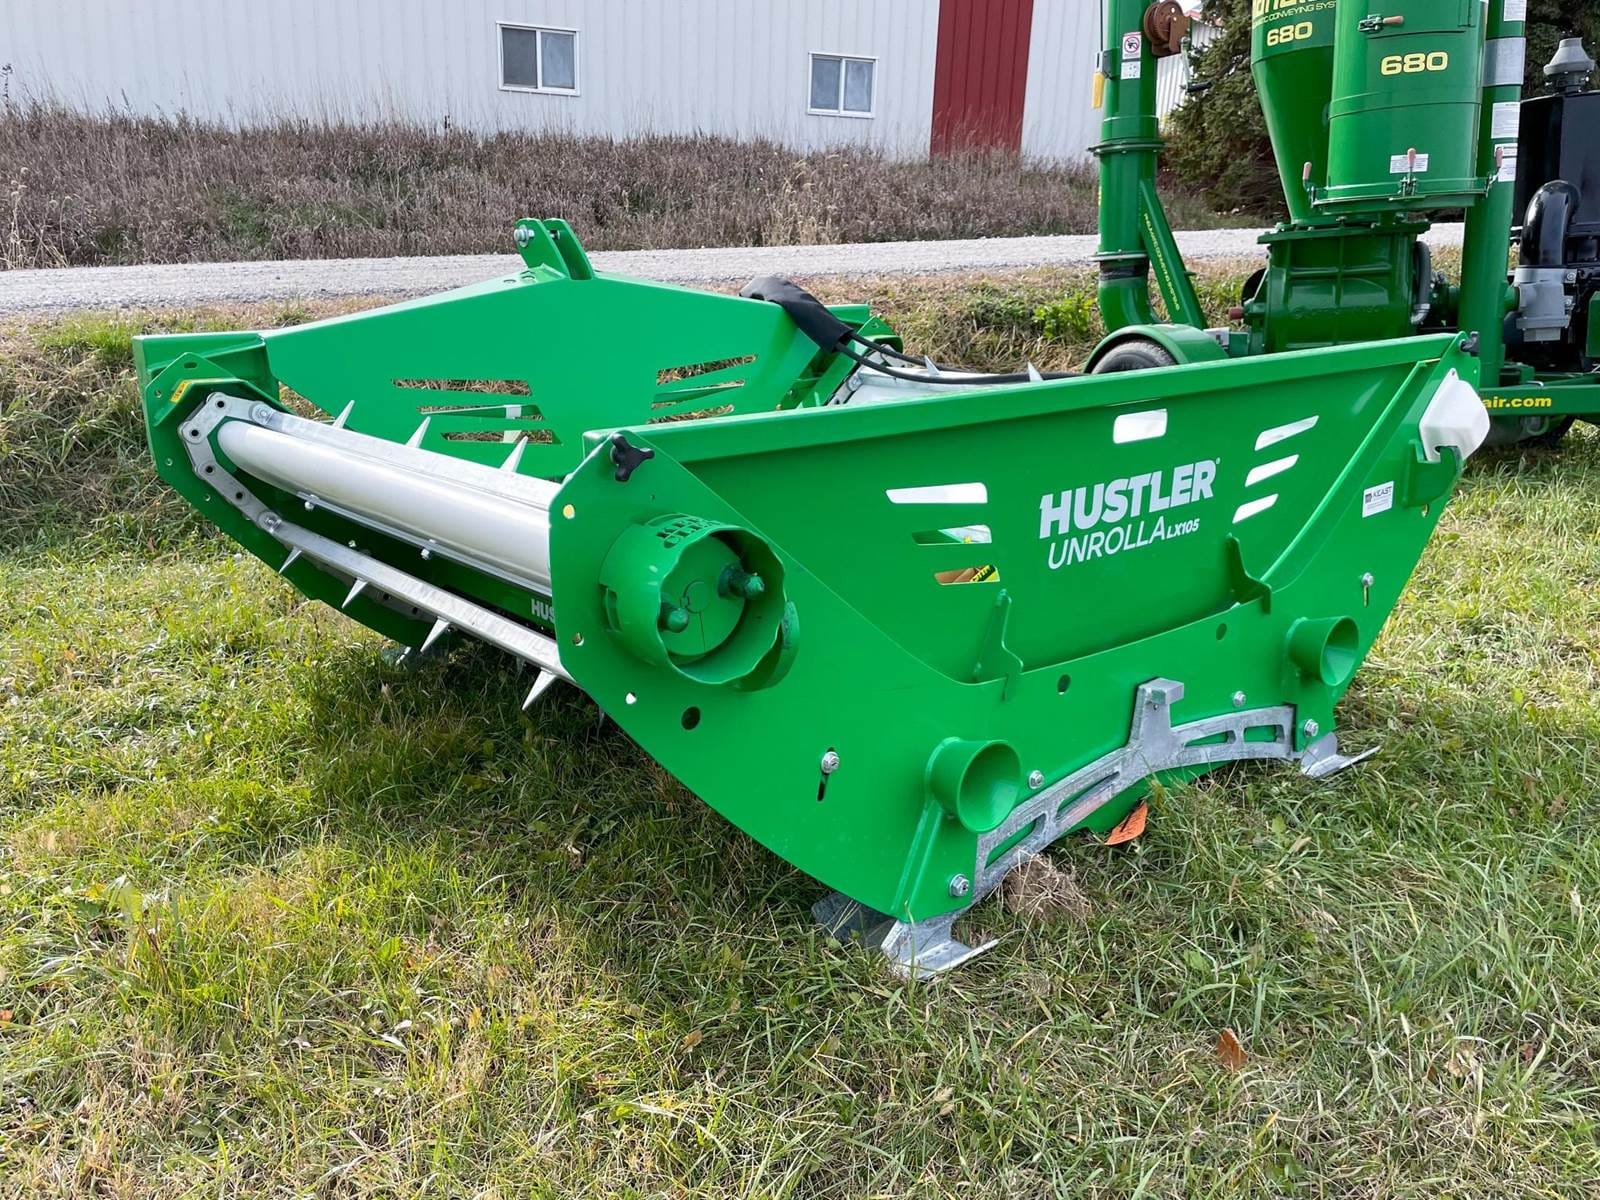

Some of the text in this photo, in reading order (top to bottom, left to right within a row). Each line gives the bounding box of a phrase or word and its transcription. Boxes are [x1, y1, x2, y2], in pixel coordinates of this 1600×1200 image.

[1269, 4, 1314, 21] CONVEYING
[1316, 1, 1336, 10] SYS
[1266, 21, 1313, 47] 680
[1380, 51, 1449, 75] 680
[1039, 459, 1217, 540] HUSTLER
[1048, 516, 1200, 569] UNROLLA LX105
